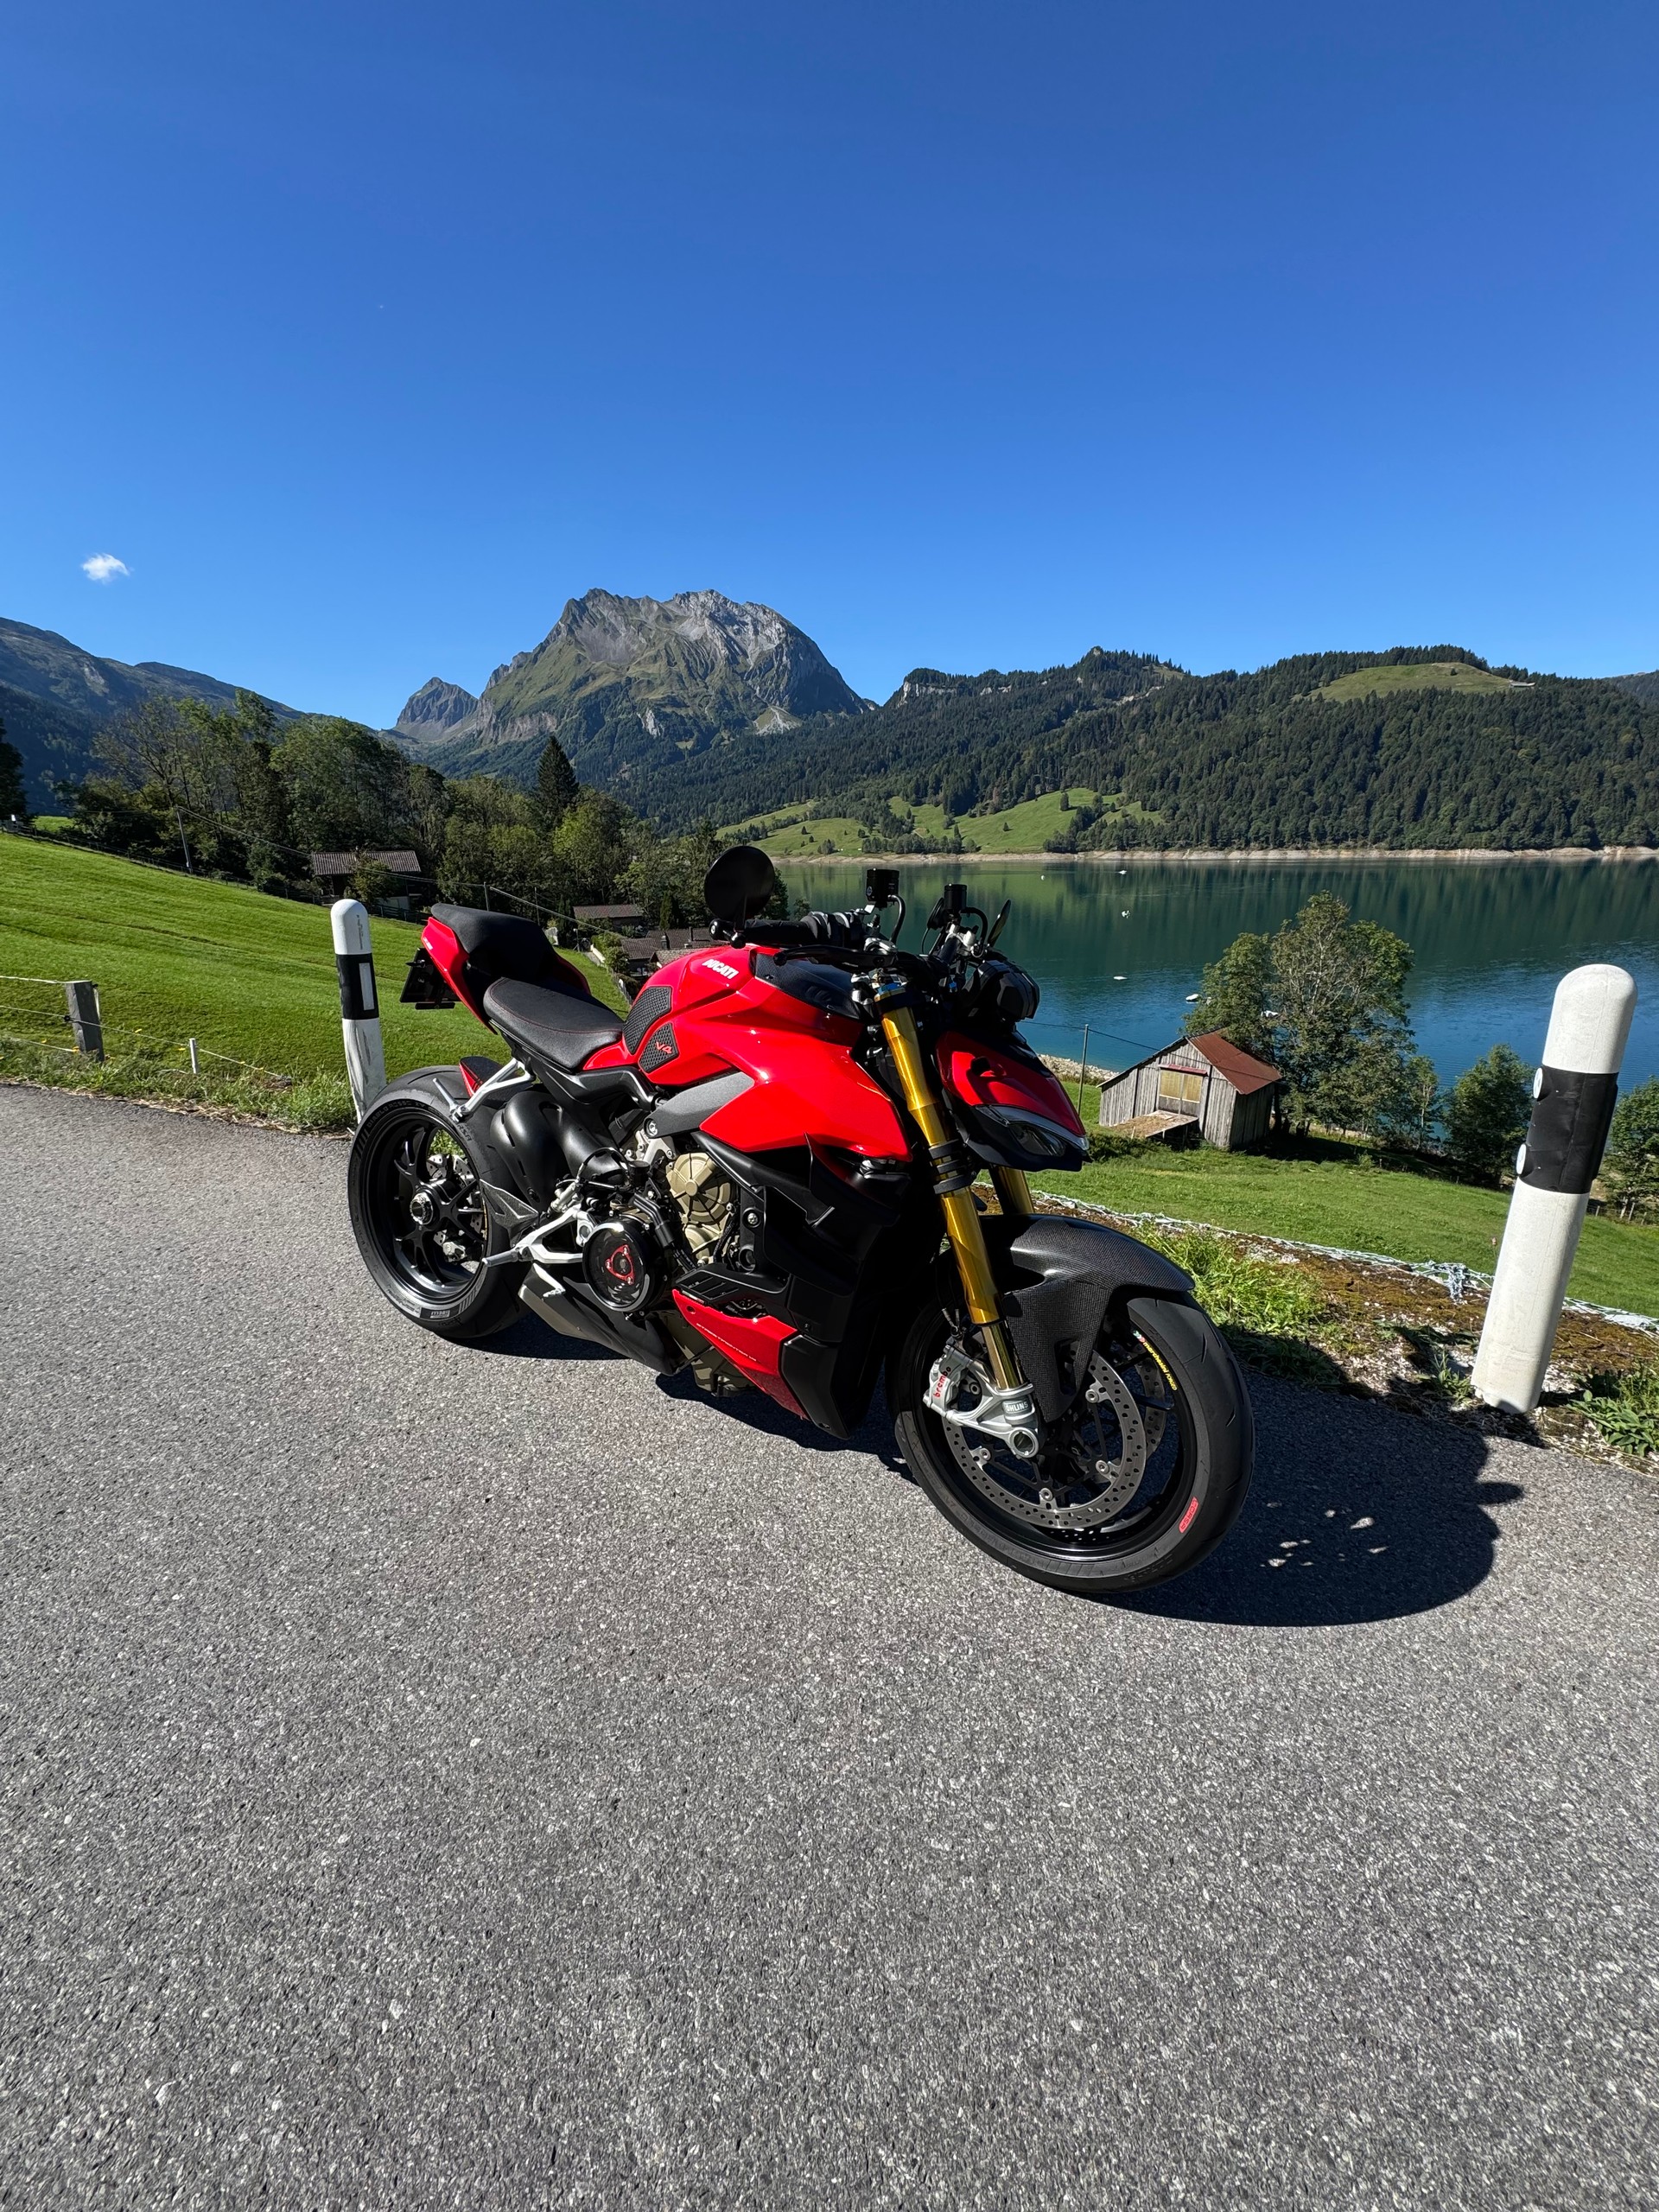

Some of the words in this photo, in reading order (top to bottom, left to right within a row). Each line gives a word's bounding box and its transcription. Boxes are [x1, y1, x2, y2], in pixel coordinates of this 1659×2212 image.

[701, 958, 739, 979] DUCATI
[657, 1041, 671, 1053] V4
[366, 1106, 389, 1128] DIABLO
[1142, 1341, 1169, 1373] marchesini
[933, 1366, 951, 1398] brembo
[1180, 1498, 1198, 1530] CORSA
